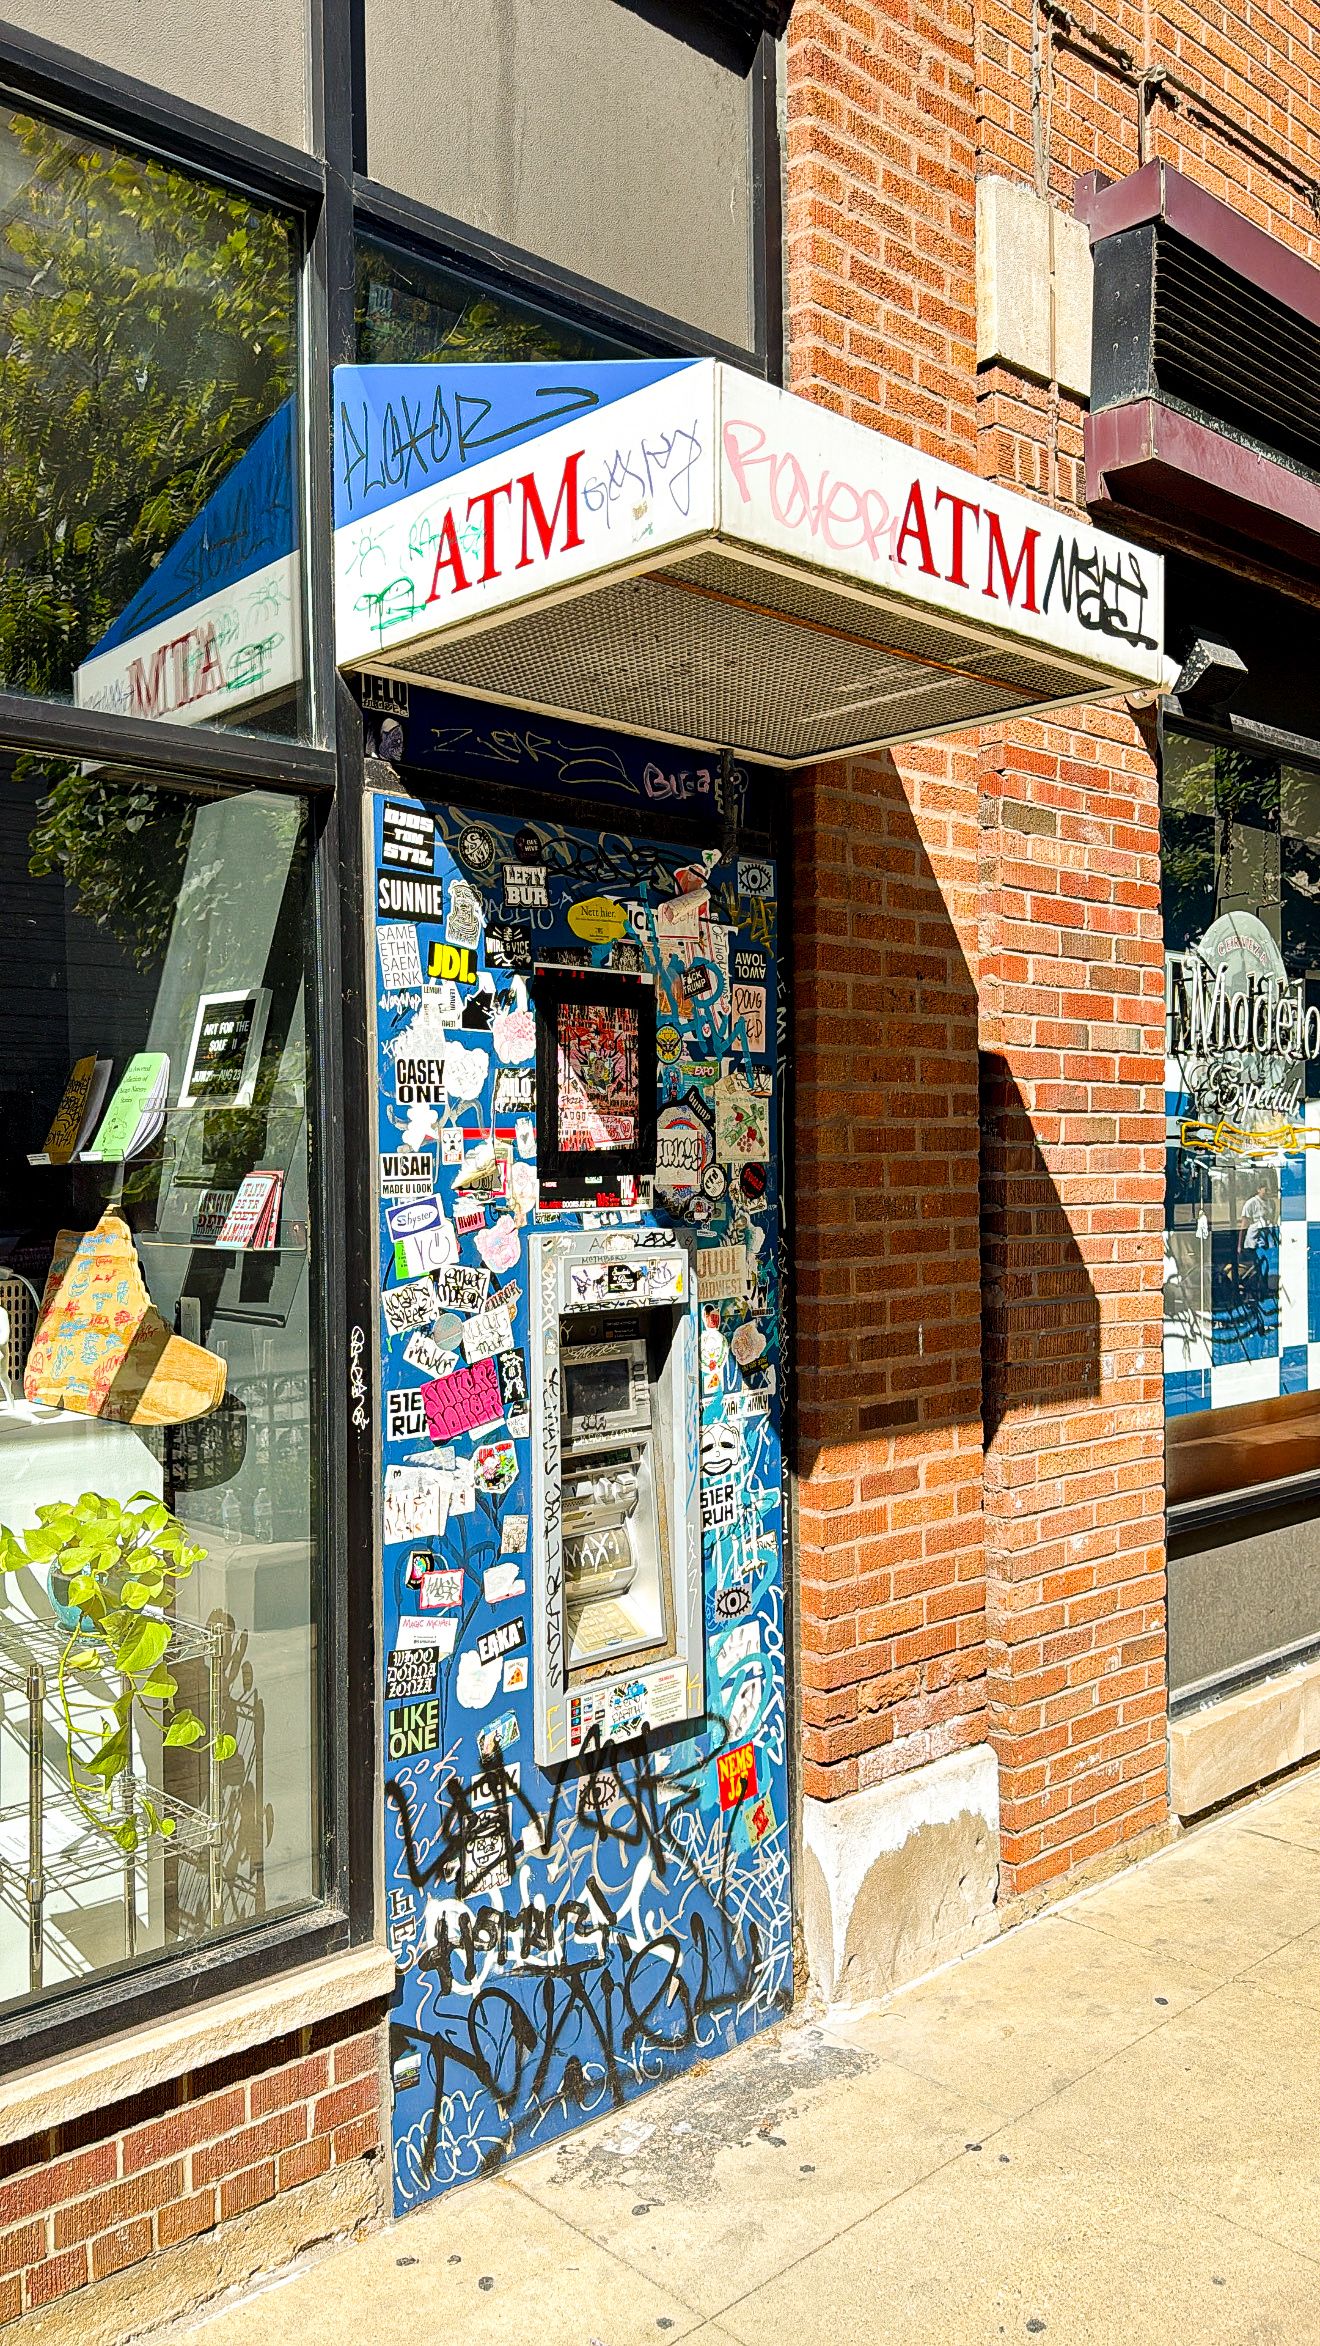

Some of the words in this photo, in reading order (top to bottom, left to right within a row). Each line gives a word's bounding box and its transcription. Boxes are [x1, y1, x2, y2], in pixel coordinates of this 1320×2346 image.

[425, 449, 585, 604] ATM
[888, 479, 1041, 614] ATM
[504, 865, 547, 886] LEFTY
[379, 878, 442, 916] SUNNIE
[506, 886, 548, 906] BUR
[580, 905, 599, 917] Nett
[378, 925, 416, 941] SAME
[380, 941, 417, 957] ETHN
[486, 937, 505, 953] WIRE
[511, 940, 530, 957] VICE
[1217, 934, 1269, 967] CERVEZA
[382, 956, 420, 972] SAEM
[735, 952, 767, 967] AWOL
[384, 971, 423, 988] FRNK
[683, 979, 706, 996] TRUMP
[1183, 955, 1320, 1061] Modelo
[204, 1023, 219, 1036] ART
[219, 1022, 235, 1034] FOR
[235, 1020, 250, 1032] THE
[396, 1059, 446, 1085] CASEY
[398, 1086, 446, 1104] ONE
[1210, 1059, 1301, 1122] Especial
[689, 1091, 712, 1123] bunny
[382, 1156, 431, 1177] VISAH
[382, 1184, 404, 1195] MADE
[405, 1183, 411, 1194] U
[412, 1183, 432, 1194] LOOK
[228, 1211, 259, 1221] JOEY
[396, 1211, 433, 1229] Shyster
[702, 1504, 734, 1527] RUH
[390, 1699, 439, 1735] LIKE
[389, 1725, 438, 1758] ONE
[719, 1745, 753, 1783] NEMS
